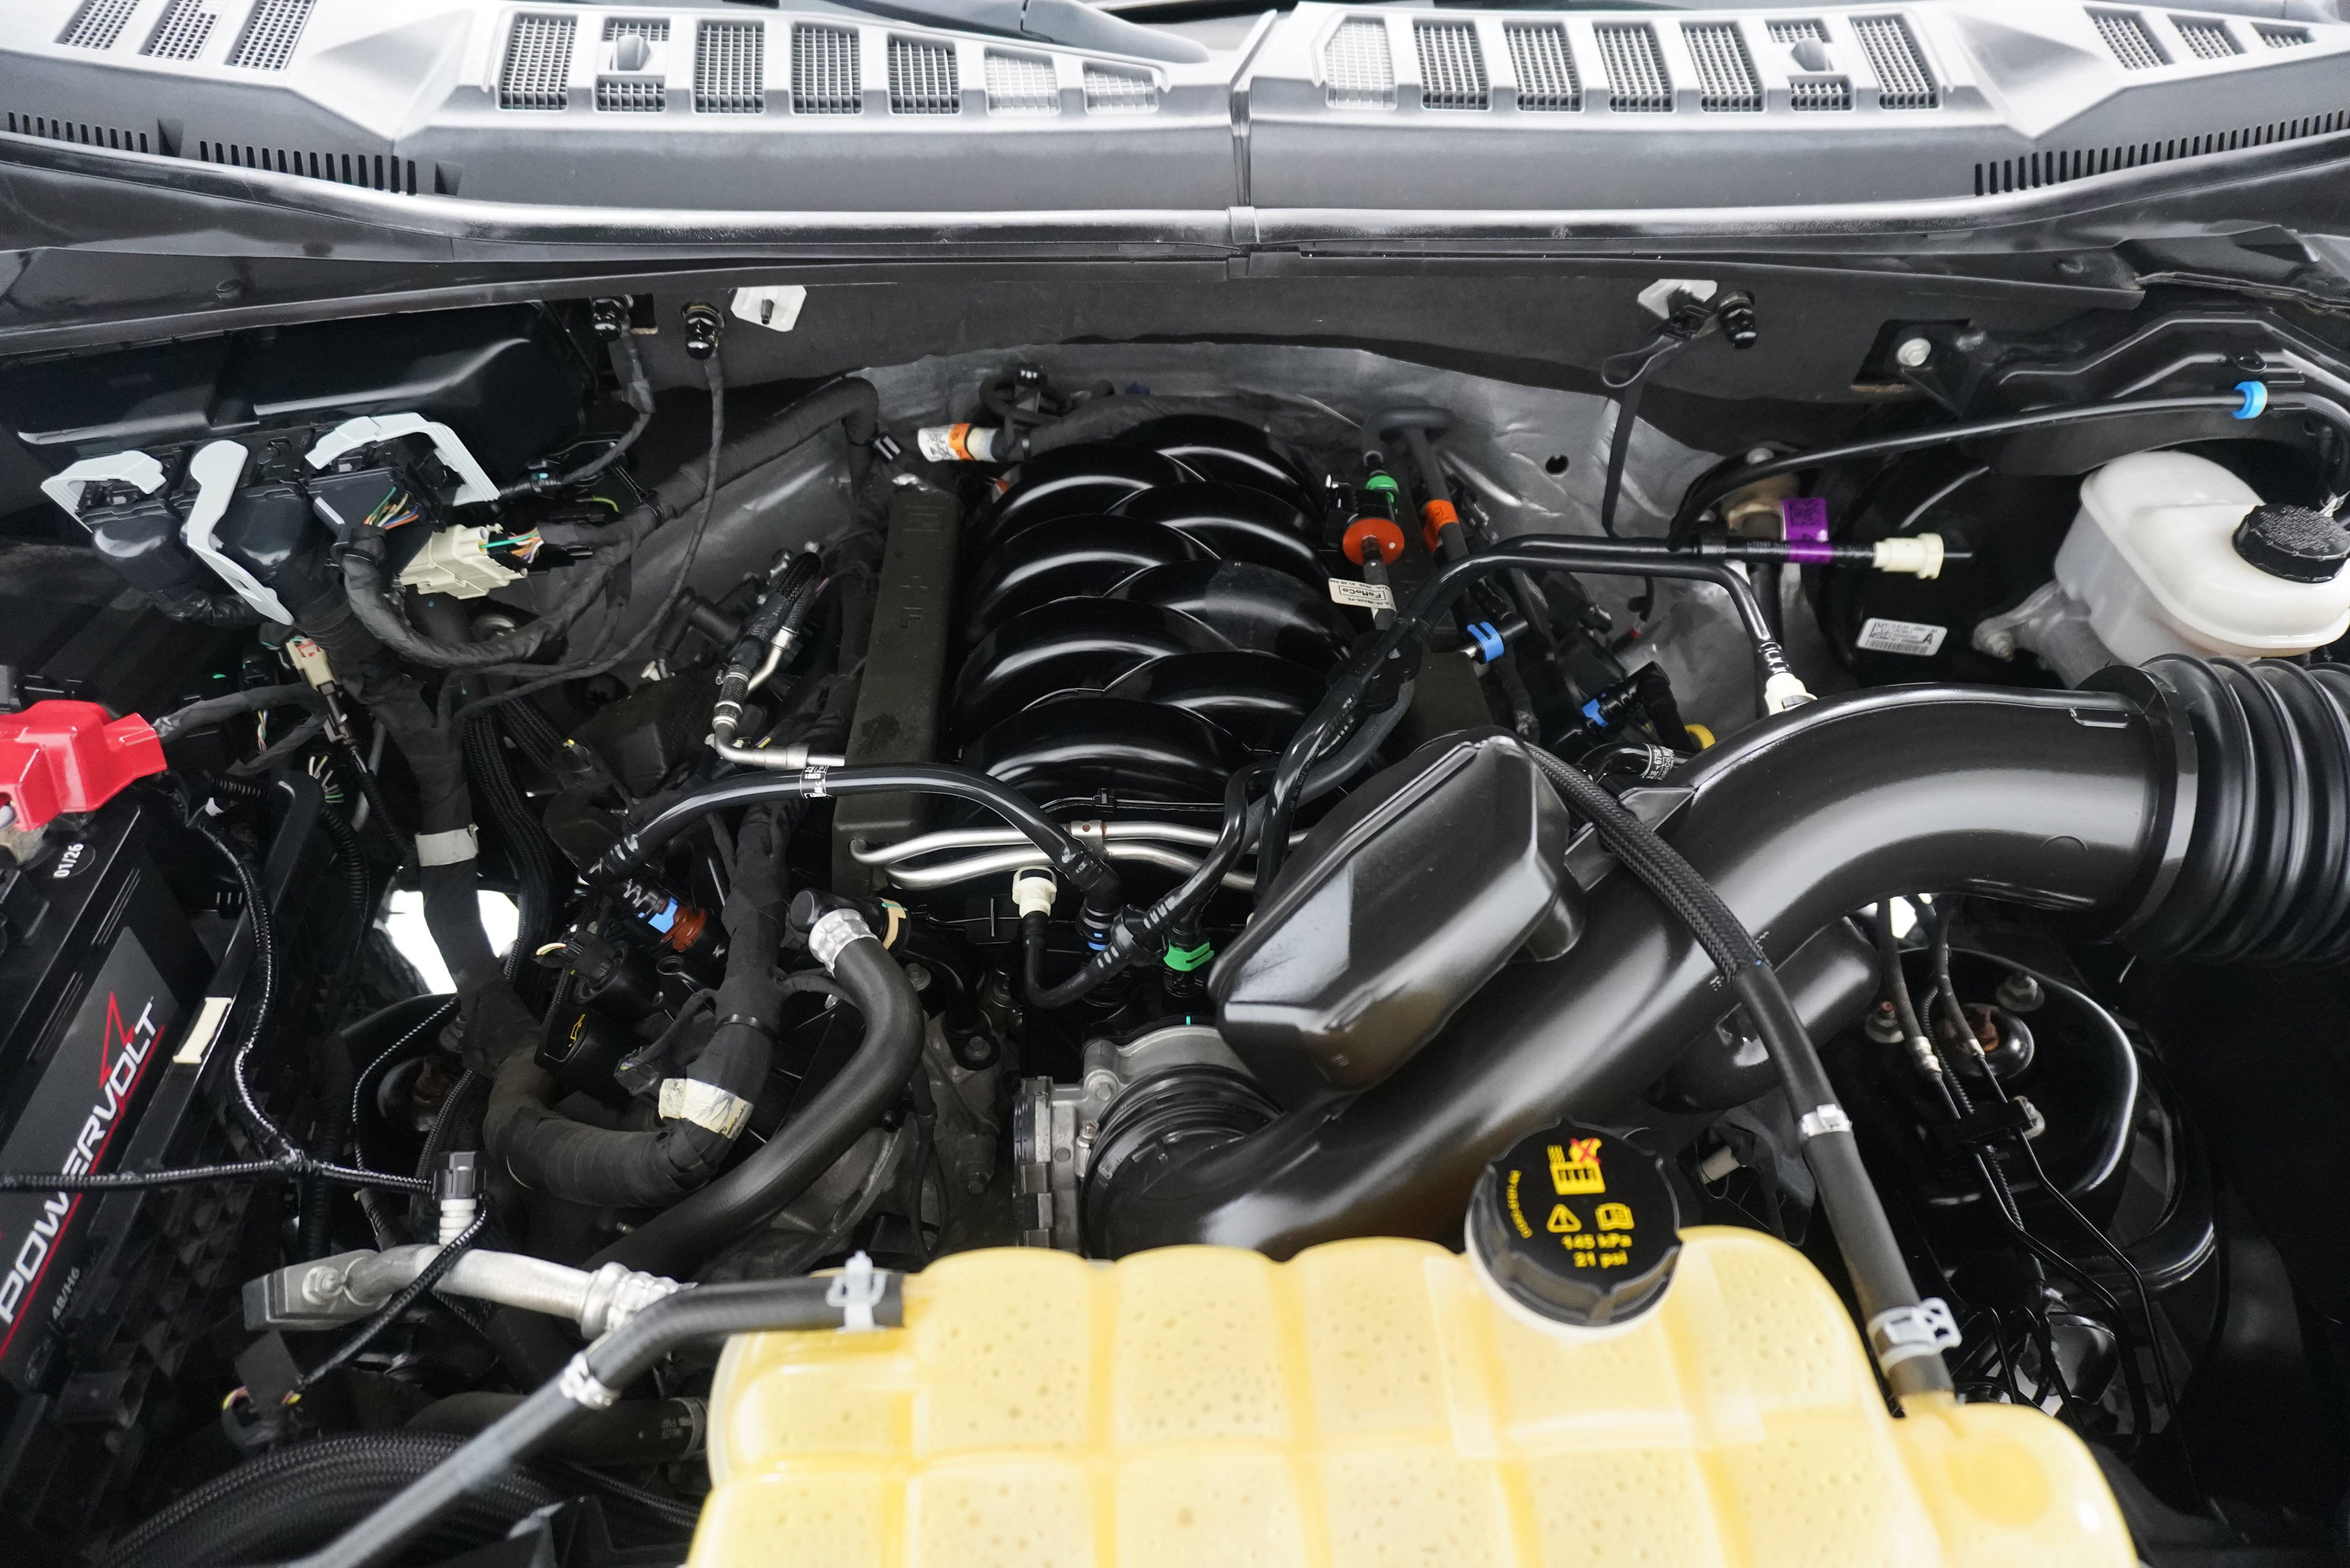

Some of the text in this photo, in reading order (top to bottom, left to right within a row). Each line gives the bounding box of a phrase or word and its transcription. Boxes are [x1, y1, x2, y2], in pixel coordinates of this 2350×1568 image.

[1342, 588, 1381, 598] FoMoCo
[53, 844, 84, 879] 01/26
[0, 1002, 156, 1325] POWERVOLT
[1561, 1232, 1633, 1250] 145 kPa
[1573, 1250, 1628, 1269] 21 psi
